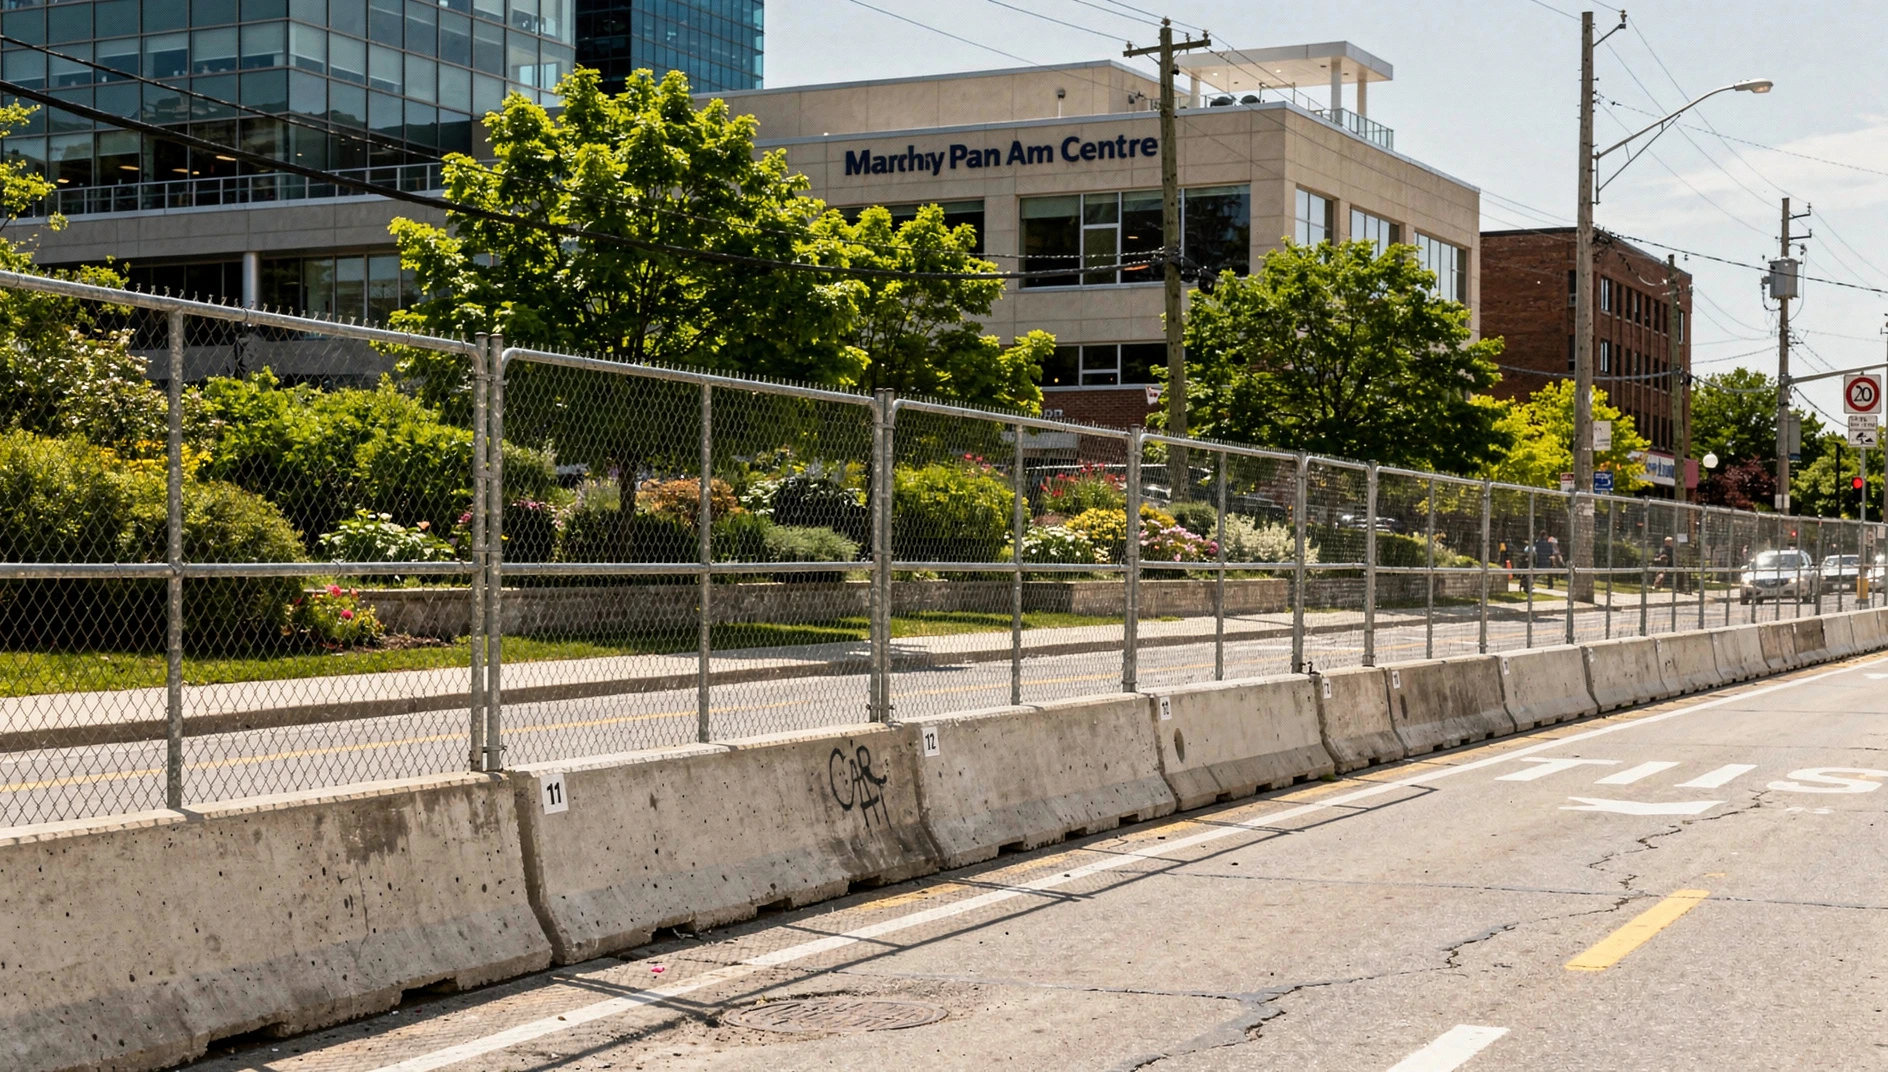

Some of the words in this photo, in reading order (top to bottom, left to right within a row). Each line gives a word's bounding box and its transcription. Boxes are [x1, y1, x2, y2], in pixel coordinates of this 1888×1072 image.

[949, 143, 1001, 169] Pan
[1005, 140, 1054, 167] Am
[1060, 134, 1158, 163] Centre
[1853, 384, 1873, 403] 20
[924, 732, 937, 751] 12
[546, 781, 562, 806] 11
